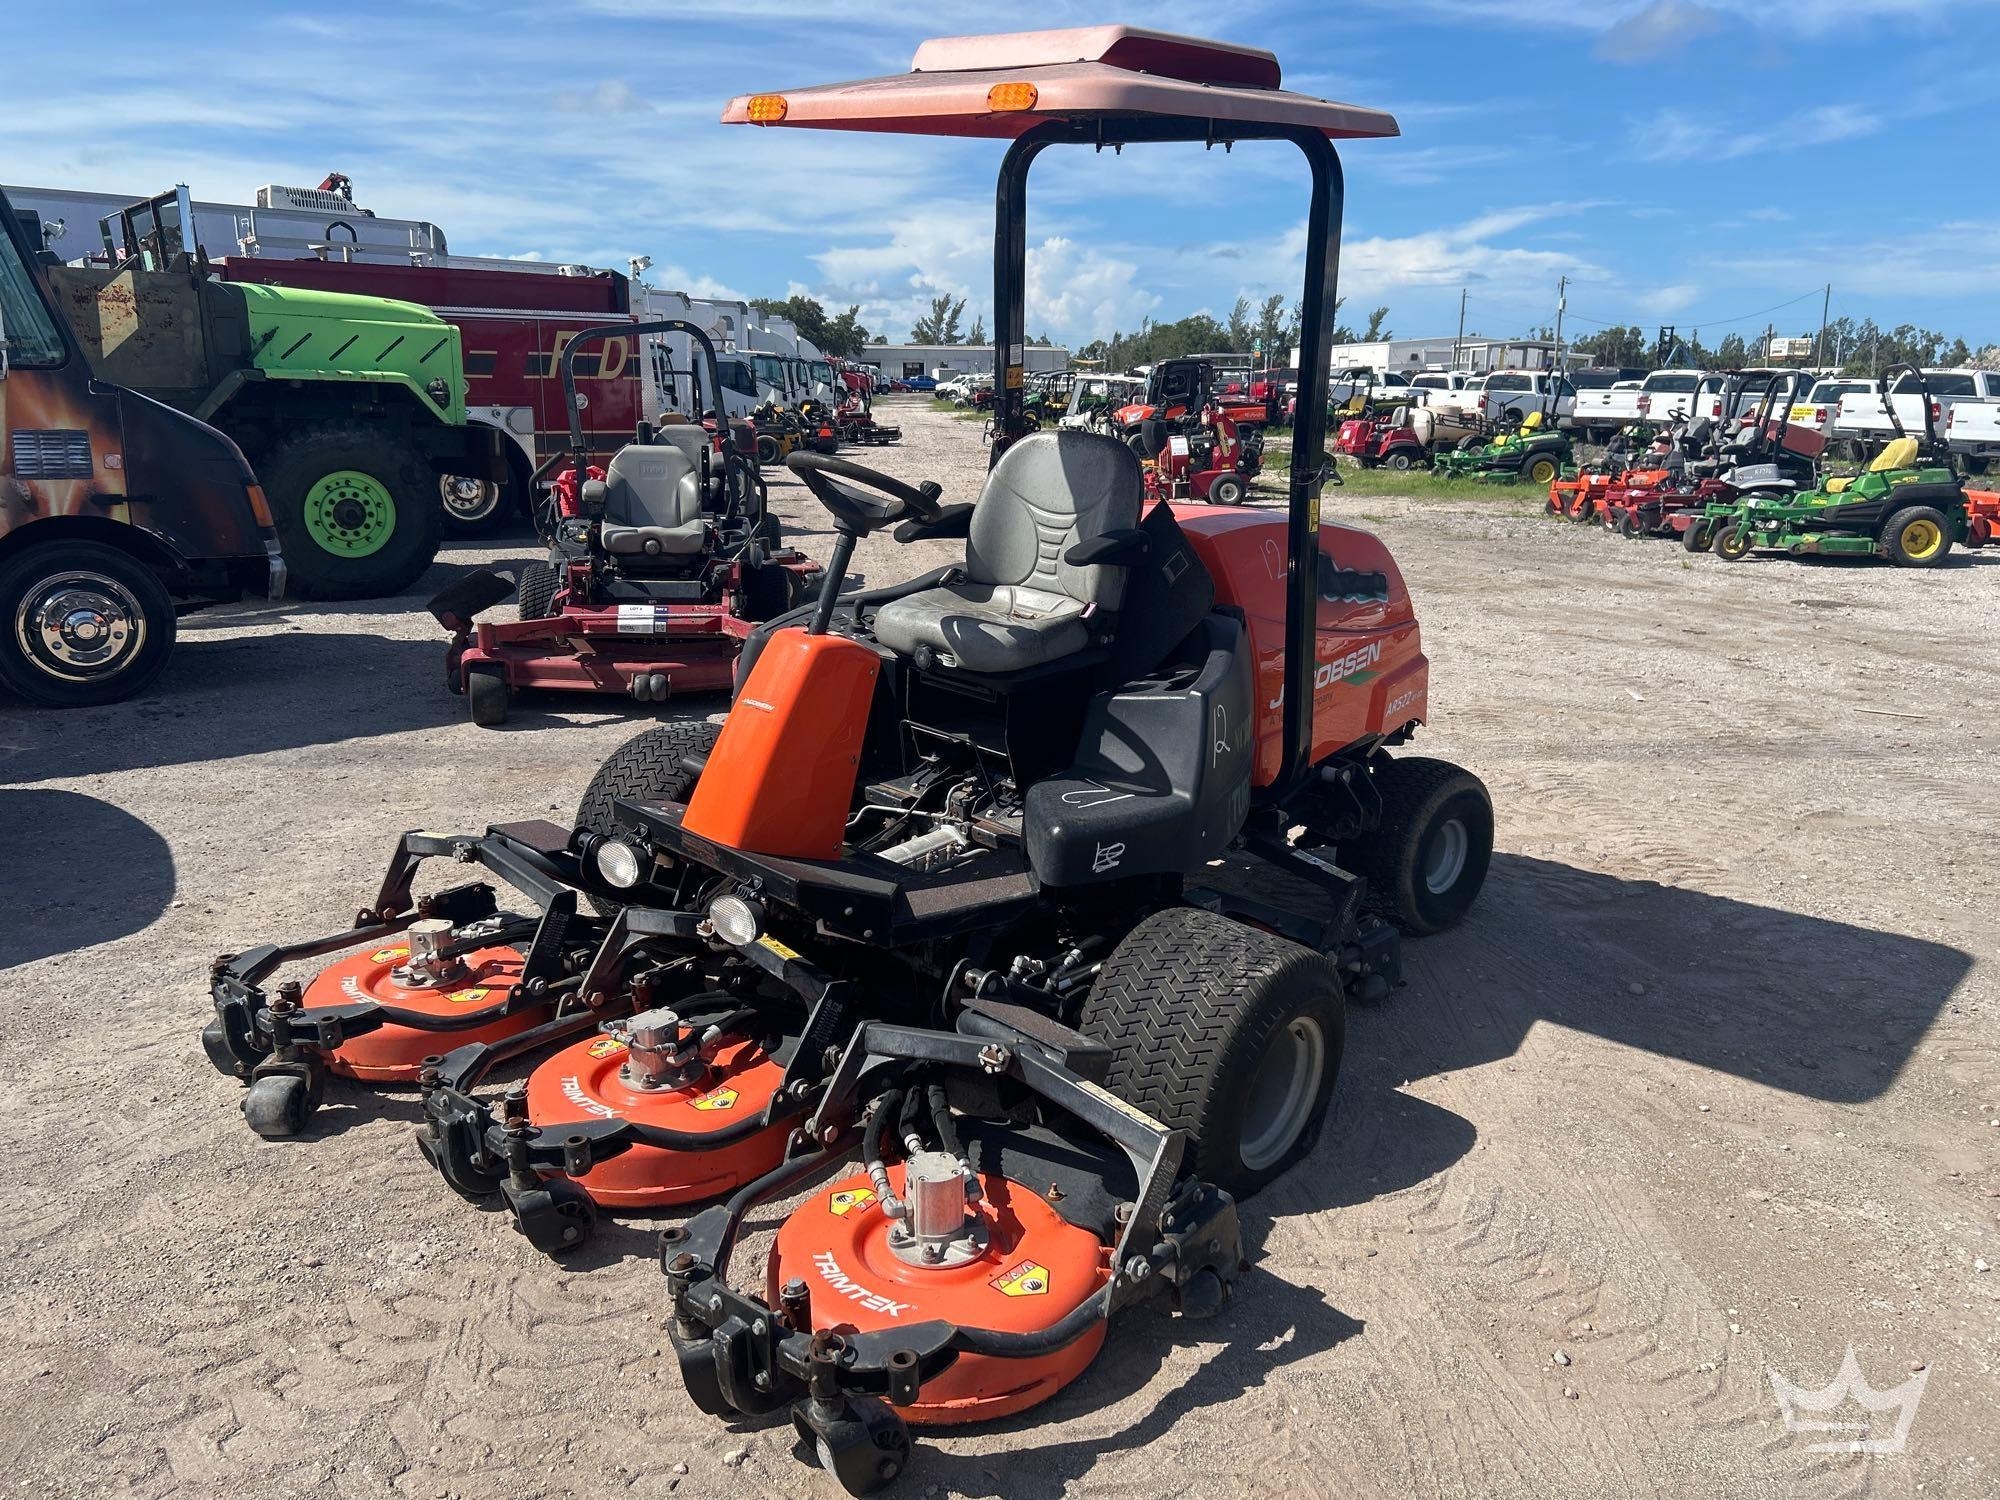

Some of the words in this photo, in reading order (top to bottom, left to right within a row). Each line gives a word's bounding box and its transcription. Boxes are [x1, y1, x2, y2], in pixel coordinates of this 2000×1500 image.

[1269, 639, 1383, 710] JOBSEN
[341, 975, 382, 1005] TRIMTE
[560, 1075, 625, 1119] TRIMTEK
[812, 1251, 911, 1317] TRIMTEK
